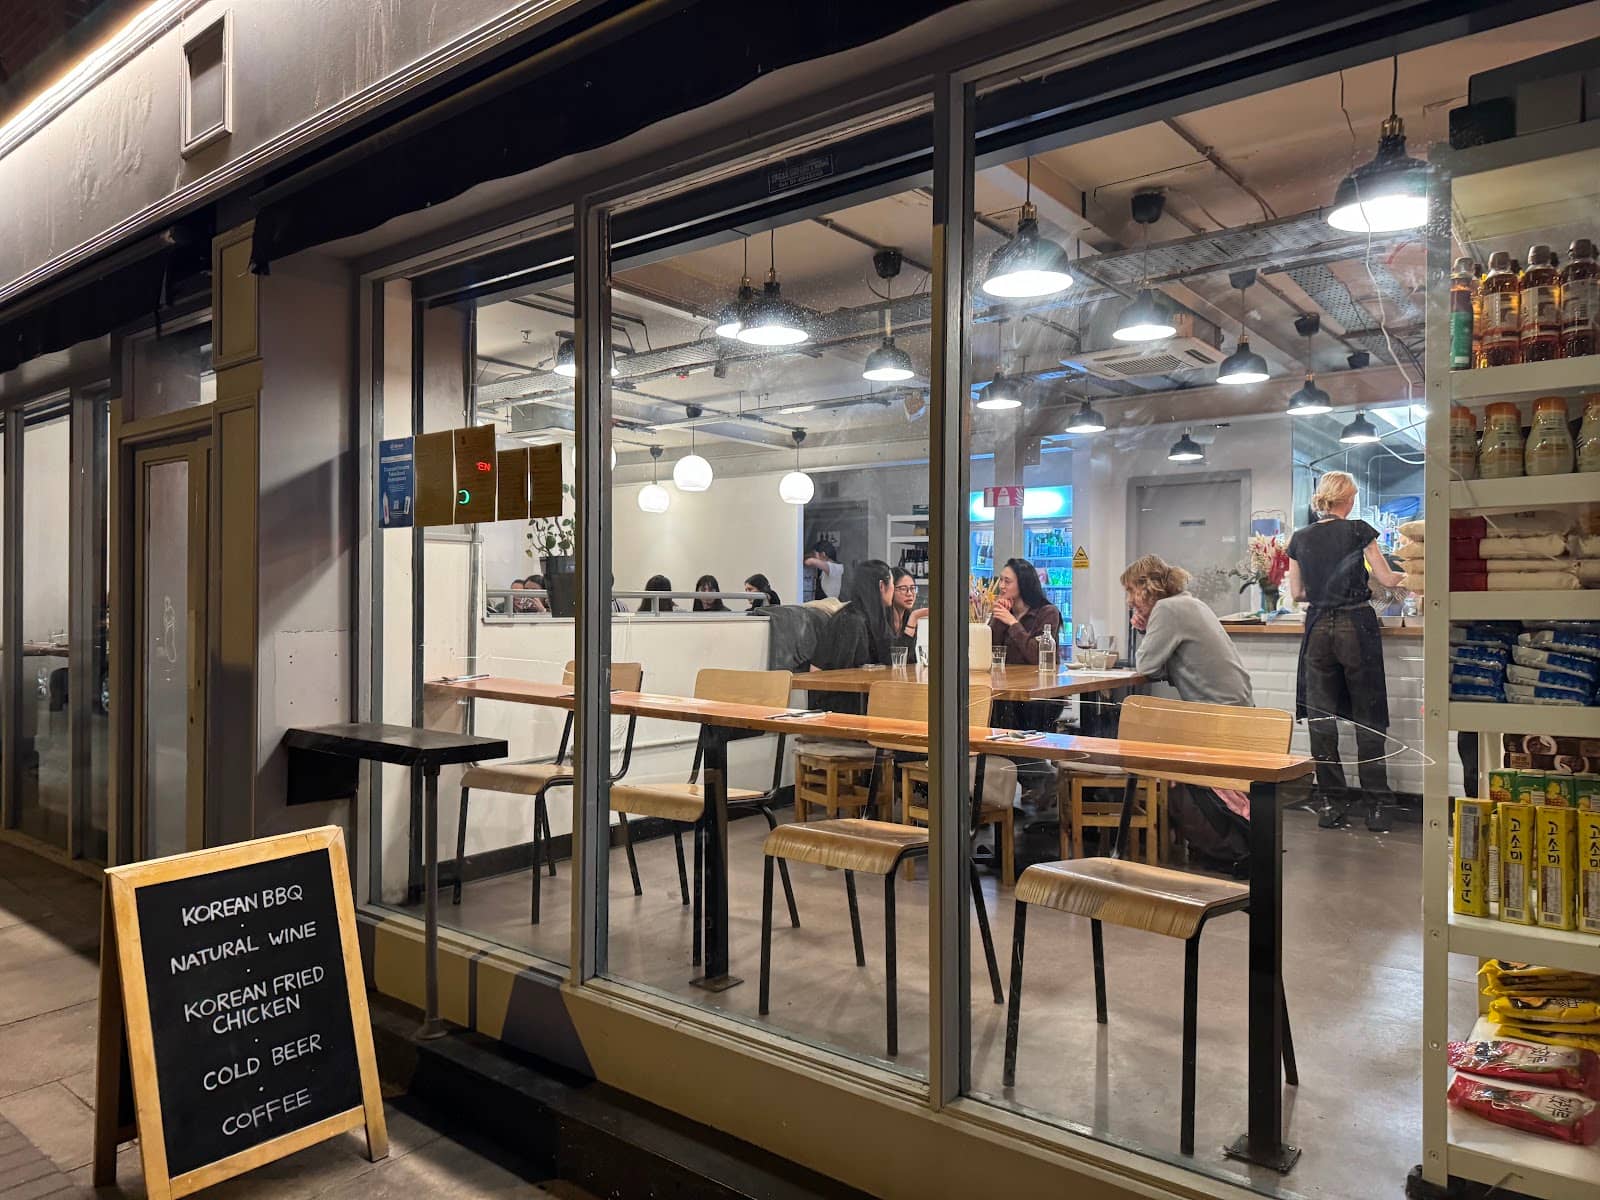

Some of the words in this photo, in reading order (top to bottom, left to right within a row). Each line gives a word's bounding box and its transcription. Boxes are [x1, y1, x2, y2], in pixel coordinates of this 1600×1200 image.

[1510, 817, 1522, 861] 고소미
[1547, 820, 1560, 865] 고소미
[1461, 861, 1473, 904] 고소미
[182, 892, 258, 927] KOREAN
[262, 884, 304, 908] BBQ
[170, 936, 260, 975] NATURAL
[267, 921, 317, 947] WINE
[184, 981, 268, 1023] KOREAN
[272, 965, 325, 997] FRIED
[212, 992, 301, 1035] CHICKEN
[203, 1056, 261, 1092] COLD
[271, 1033, 323, 1066] BEER
[222, 1089, 311, 1135] COFFEE
